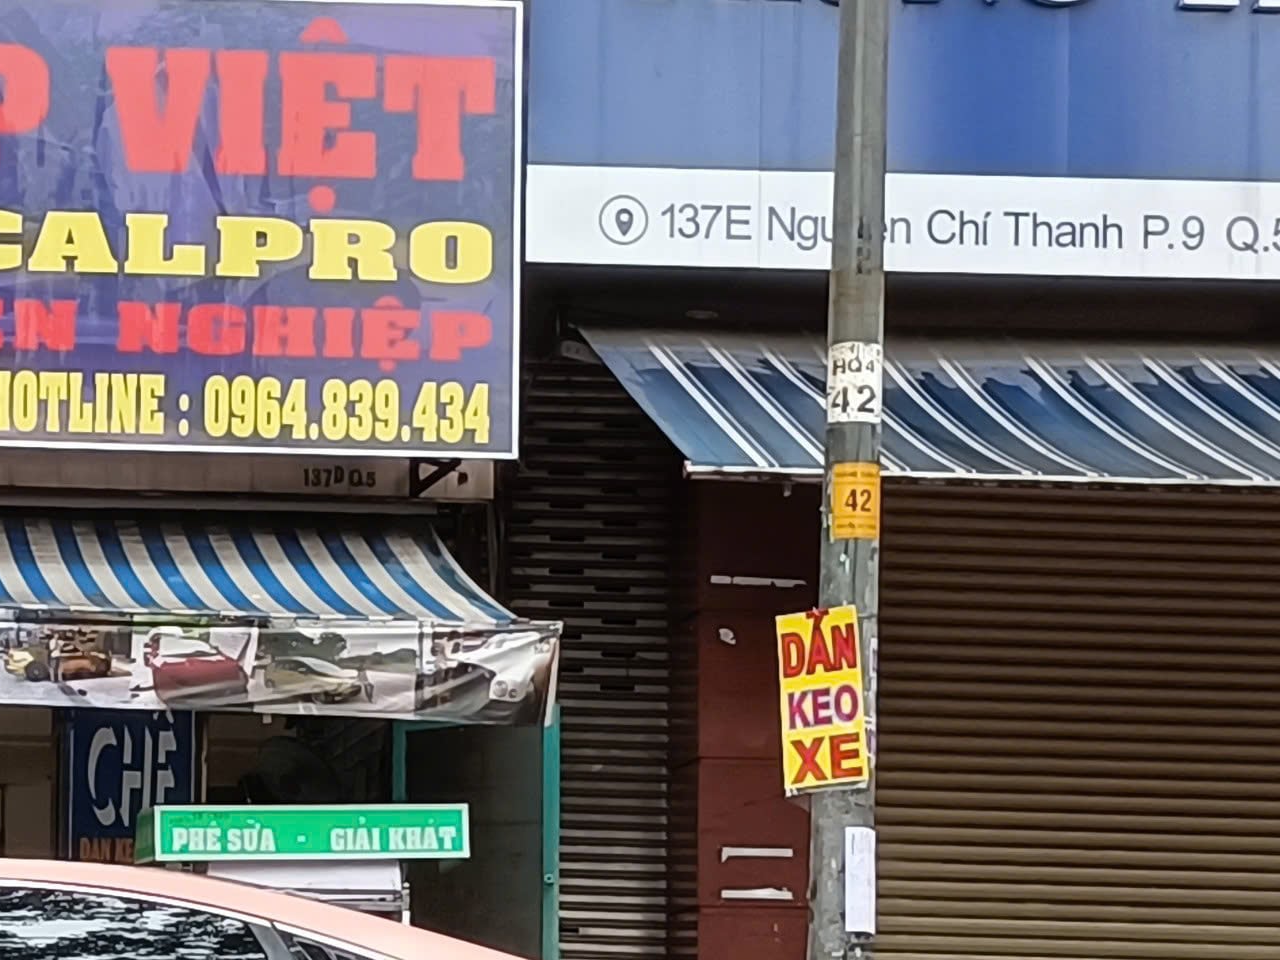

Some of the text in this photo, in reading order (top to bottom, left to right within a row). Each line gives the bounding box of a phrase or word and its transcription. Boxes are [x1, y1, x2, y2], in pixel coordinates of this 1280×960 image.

[106, 17, 496, 212] VIỆT
[661, 203, 752, 240] 137E
[927, 209, 991, 245] Chí
[1003, 211, 1122, 249] Thanh
[1143, 214, 1205, 250] P.9
[117, 296, 492, 372] NGHIỆP
[204, 374, 490, 444] 0964.839.434
[831, 384, 877, 413] 42
[845, 489, 872, 513] 42
[788, 684, 859, 730] KEO
[790, 732, 863, 784] XE
[330, 816, 380, 852] GIẢI
[388, 818, 456, 851] KHÁT
